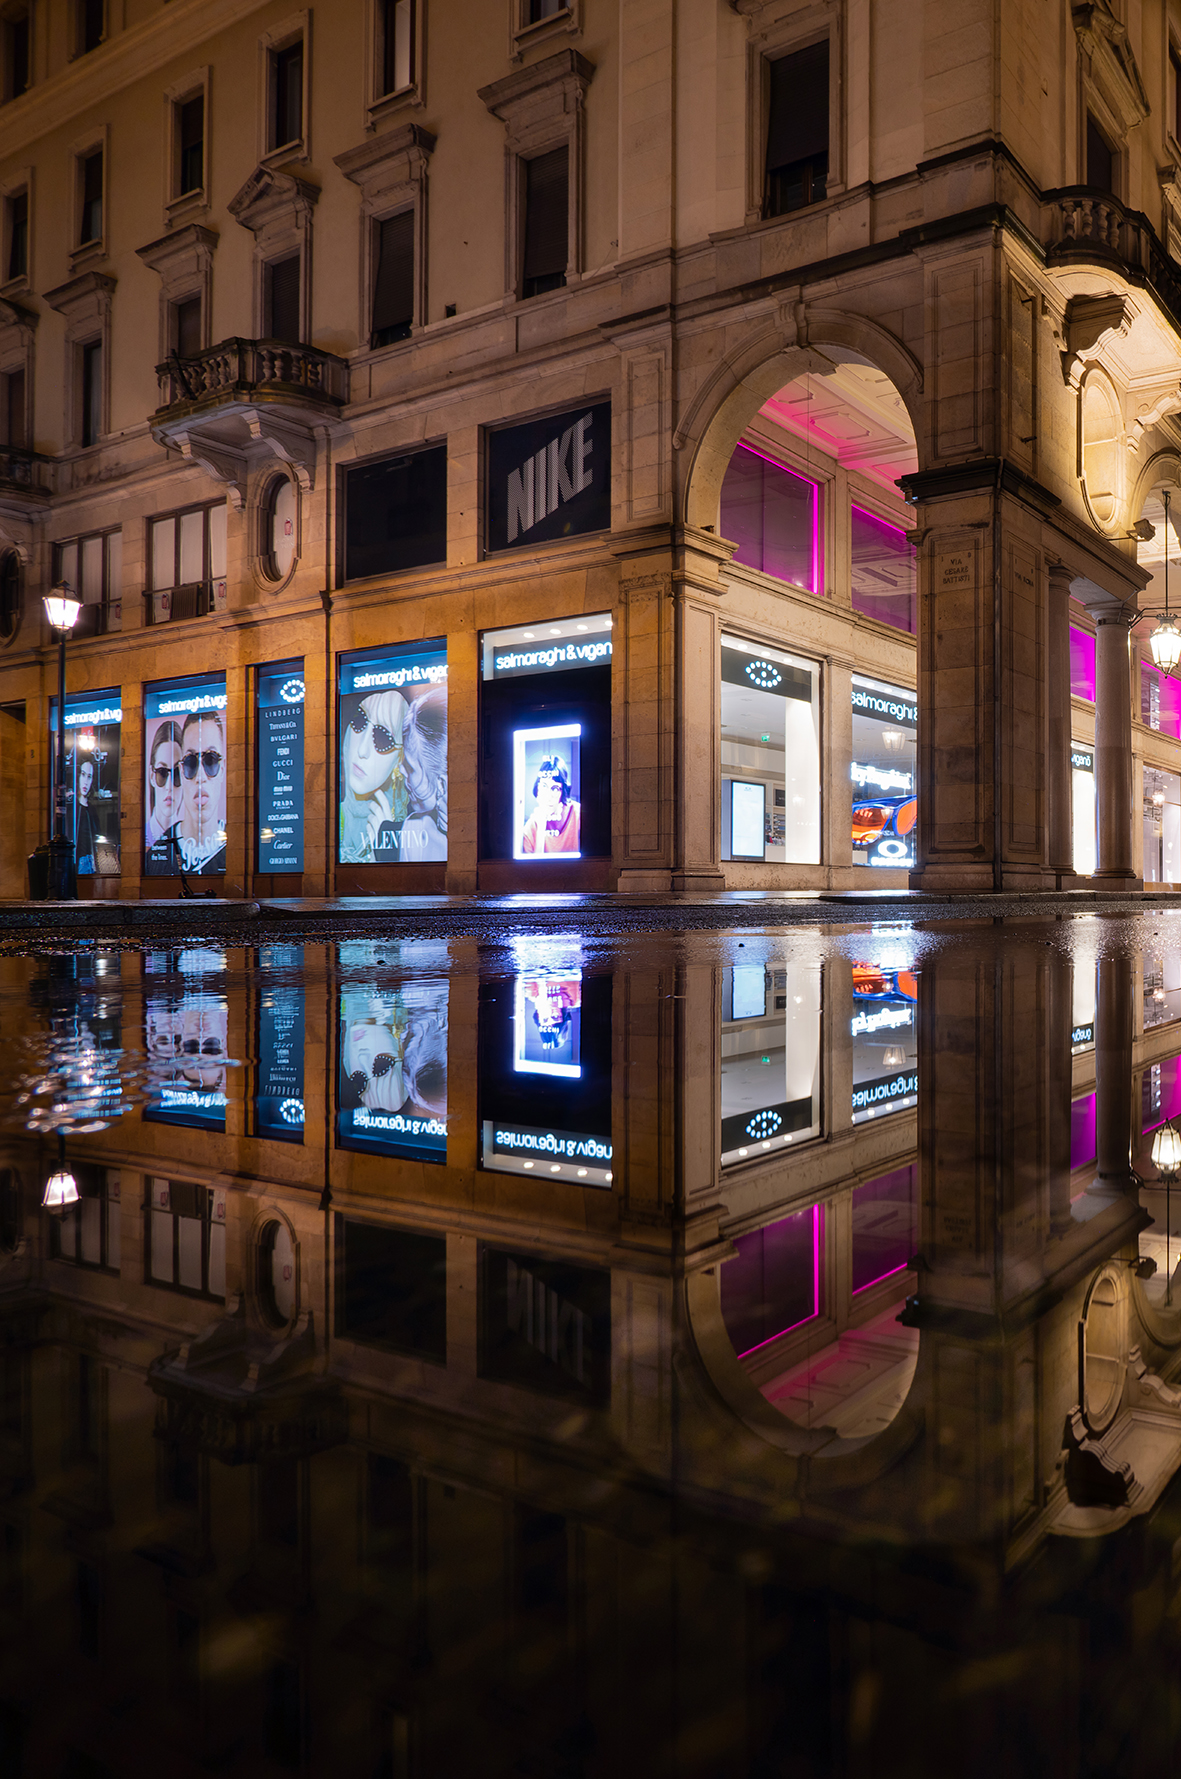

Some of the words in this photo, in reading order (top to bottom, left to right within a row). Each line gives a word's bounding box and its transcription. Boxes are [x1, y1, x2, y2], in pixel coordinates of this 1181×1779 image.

[507, 411, 593, 544] NIKE
[942, 575, 970, 584] BATTISTI
[496, 646, 565, 669] salmoiraghi
[566, 644, 577, 660] &
[576, 642, 613, 661] vigan
[353, 667, 412, 688] salmoiraghi
[412, 665, 422, 681] &
[159, 697, 204, 714] salmoiraghi
[265, 708, 301, 718] LINDBERG
[851, 691, 913, 720] salmoiraghi
[64, 709, 104, 724] salmoiraghi
[270, 734, 297, 742] BVLGARI
[277, 771, 290, 780] Dior
[273, 840, 293, 849] Cartier
[360, 829, 428, 850] VALENTINO
